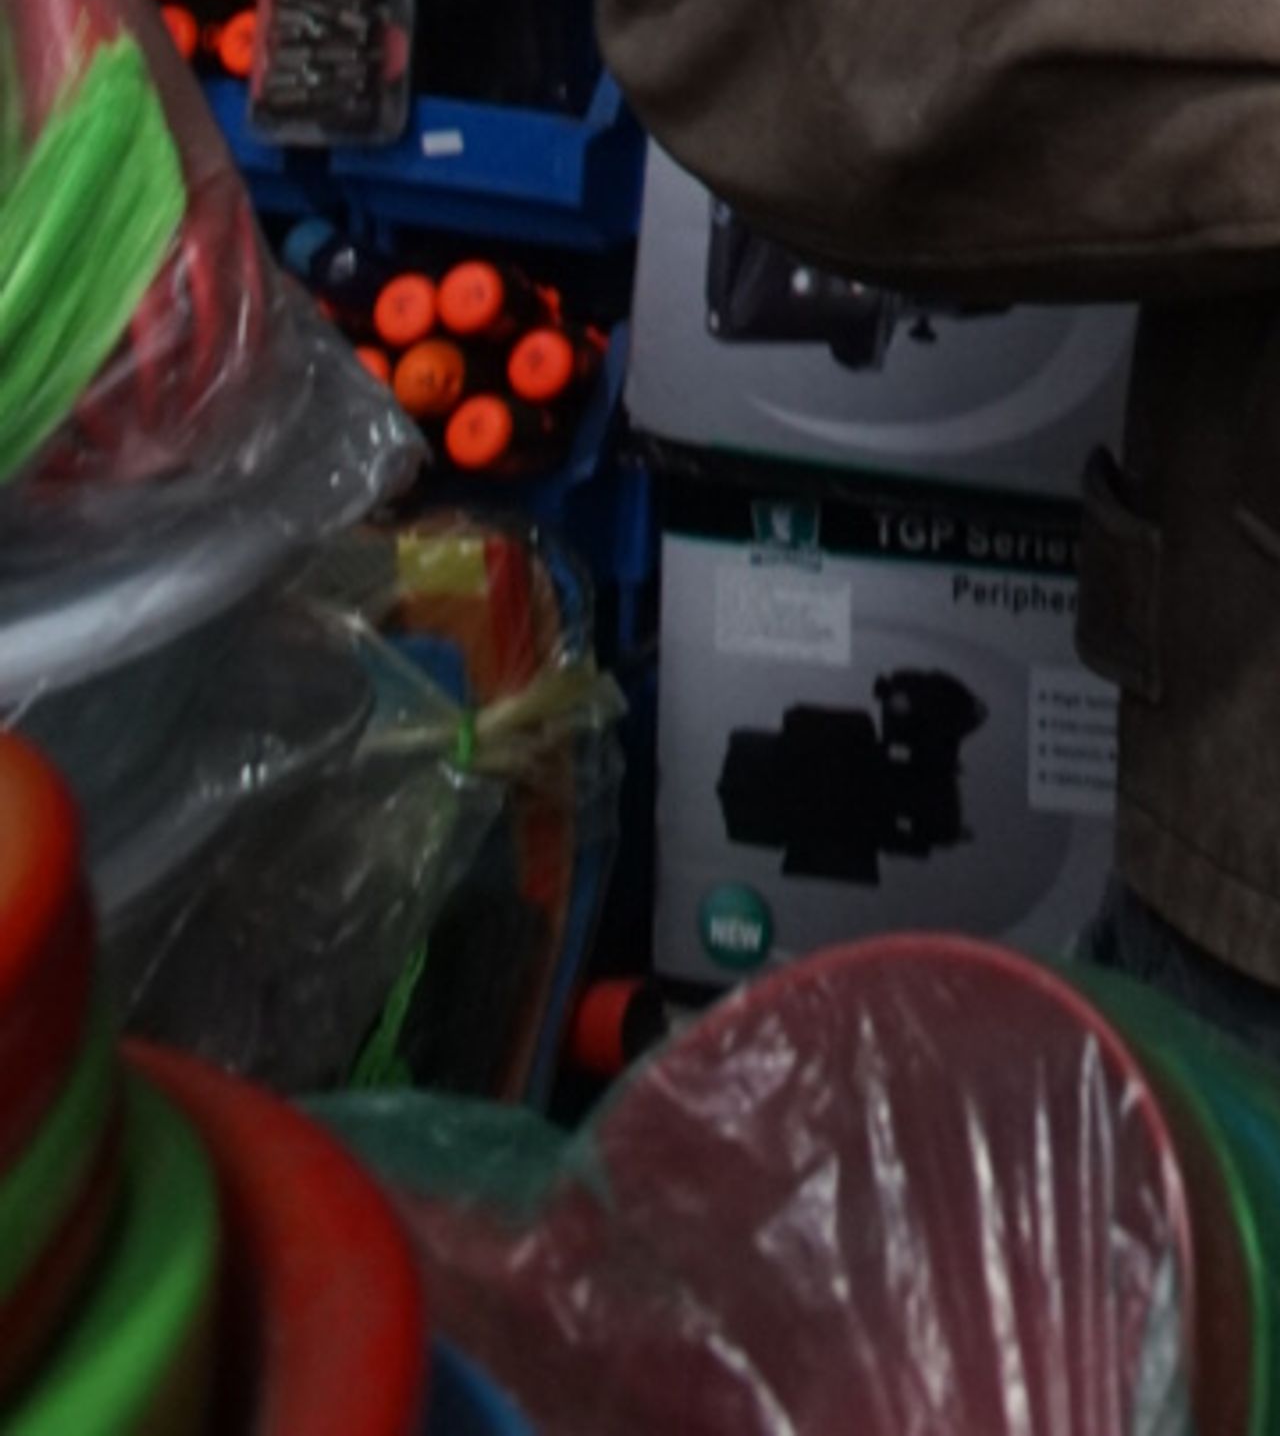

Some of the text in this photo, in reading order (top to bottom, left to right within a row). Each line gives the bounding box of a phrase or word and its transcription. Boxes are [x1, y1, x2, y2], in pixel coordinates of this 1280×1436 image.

[874, 509, 956, 553] TGP
[952, 574, 1077, 614] Peripher
[709, 914, 764, 952] NEW
